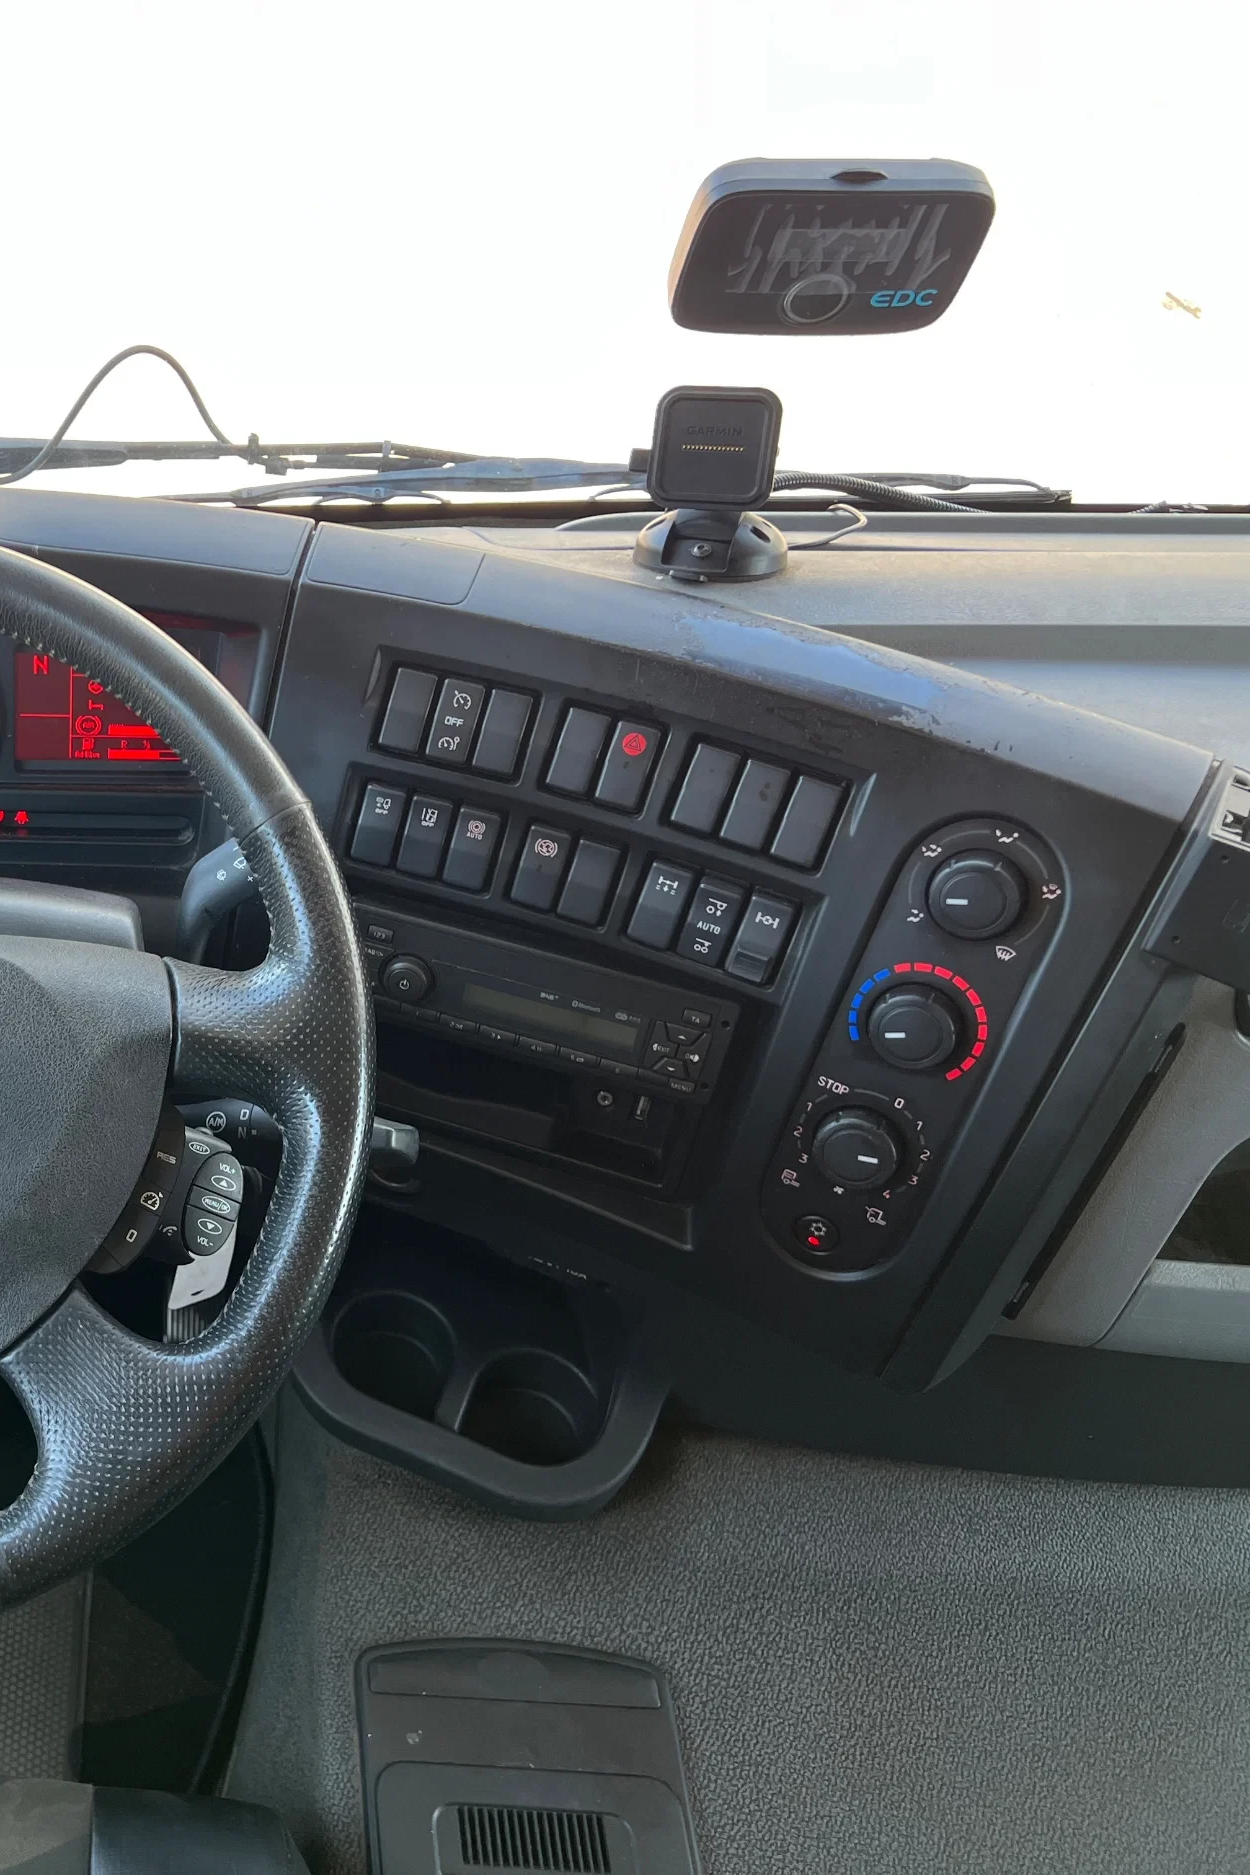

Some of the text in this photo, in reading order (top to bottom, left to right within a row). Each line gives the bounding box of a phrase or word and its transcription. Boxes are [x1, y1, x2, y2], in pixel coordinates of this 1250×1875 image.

[870, 288, 938, 308] EDC
[686, 426, 743, 437] GARMIN
[32, 655, 48, 675] N
[444, 716, 464, 727] OFF
[466, 831, 483, 840] AUTO
[696, 920, 721, 935] AUTO
[691, 1016, 700, 1024] TA
[671, 1083, 692, 1093] MENU
[817, 1076, 849, 1095] STOP
[806, 1102, 813, 1112] 1
[793, 1126, 803, 1137] 2
[916, 1121, 923, 1131] 1
[193, 1144, 206, 1152] EXIT
[156, 1151, 176, 1165] RES
[799, 1153, 809, 1164] 3
[920, 1150, 930, 1161] 2
[218, 1163, 236, 1174] VOL+
[908, 1175, 919, 1185] 3
[882, 1189, 891, 1199] 4
